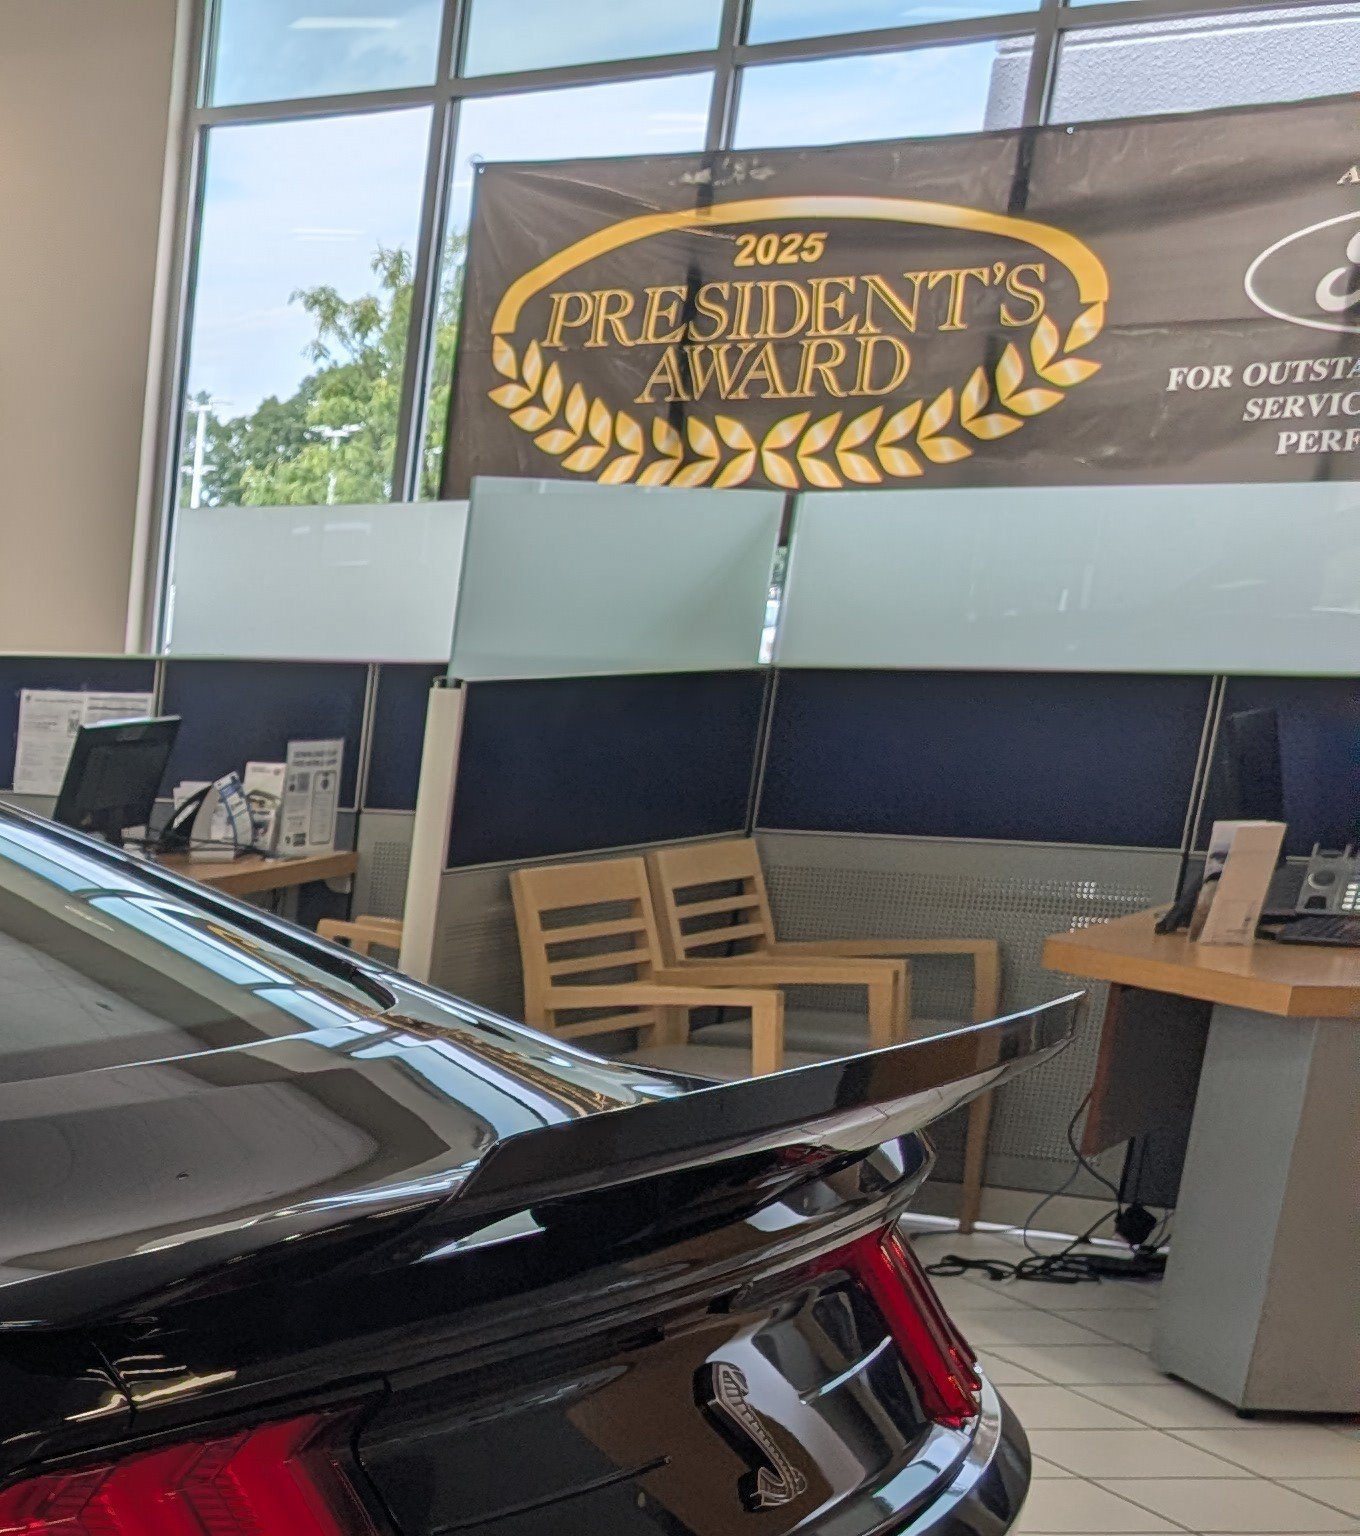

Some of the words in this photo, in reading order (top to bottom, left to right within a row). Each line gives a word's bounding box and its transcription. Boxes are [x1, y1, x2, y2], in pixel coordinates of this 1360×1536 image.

[733, 231, 828, 267] 2025
[541, 262, 1046, 348] PRESIDENT'S
[639, 335, 912, 404] AWARD
[1166, 364, 1233, 392] FOR
[1242, 391, 1360, 421] SERVIC
